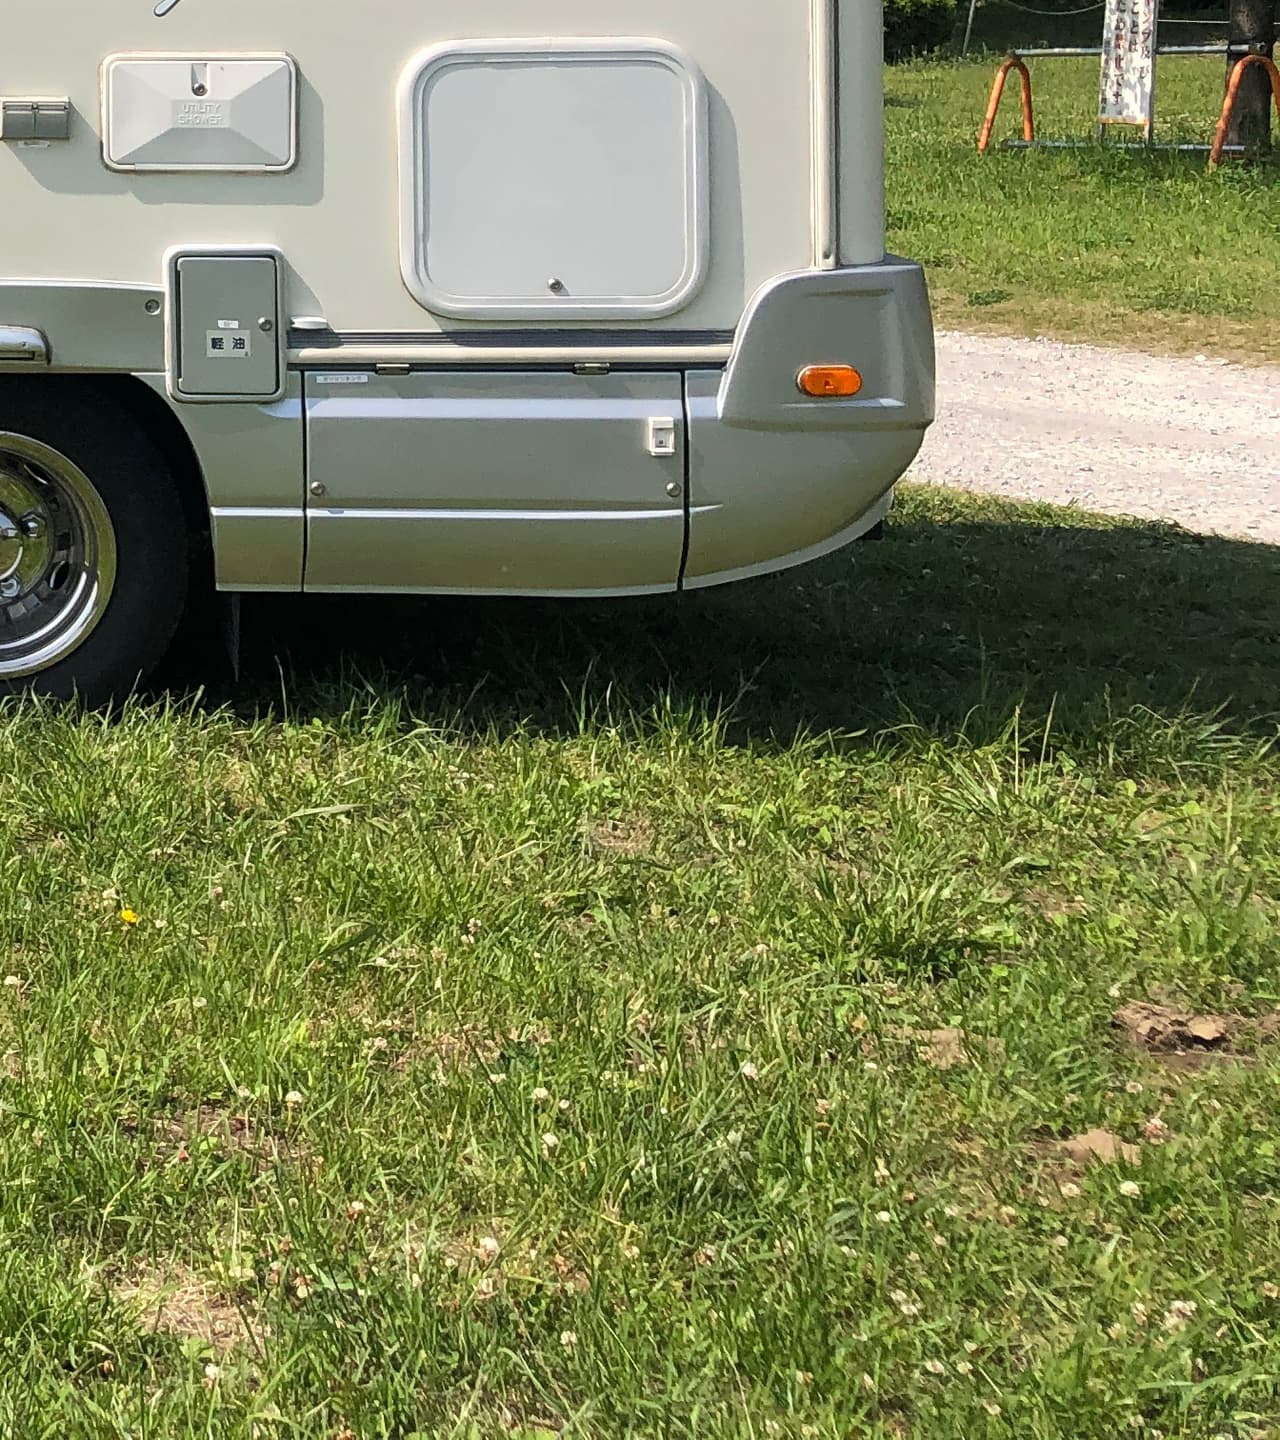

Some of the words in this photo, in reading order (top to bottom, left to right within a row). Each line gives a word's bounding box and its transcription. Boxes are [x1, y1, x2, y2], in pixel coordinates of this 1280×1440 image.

[183, 103, 222, 114] UTILITY
[178, 114, 223, 125] SHOWER
[211, 337, 245, 350] 軽油
